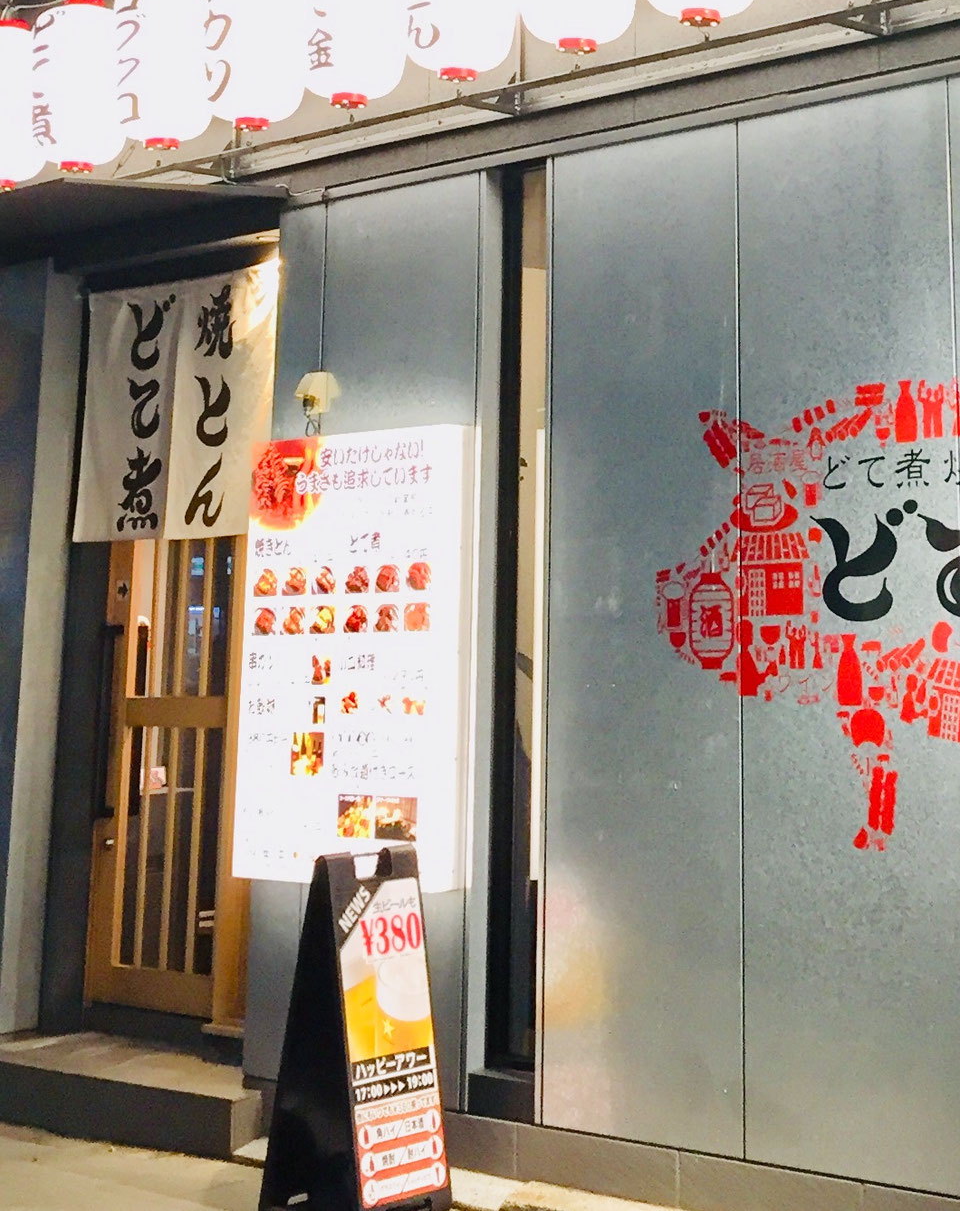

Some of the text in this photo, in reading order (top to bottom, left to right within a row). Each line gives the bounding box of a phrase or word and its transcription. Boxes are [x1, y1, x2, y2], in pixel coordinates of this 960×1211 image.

[116, 293, 176, 532] どて煮
[184, 284, 237, 528] 焼とん
[700, 604, 723, 638] 酒
[338, 884, 371, 933] NEWS
[360, 912, 421, 956] ¥380
[354, 1071, 434, 1102] 17:00 19:00
[355, 1051, 427, 1080] ハッピーアワー
